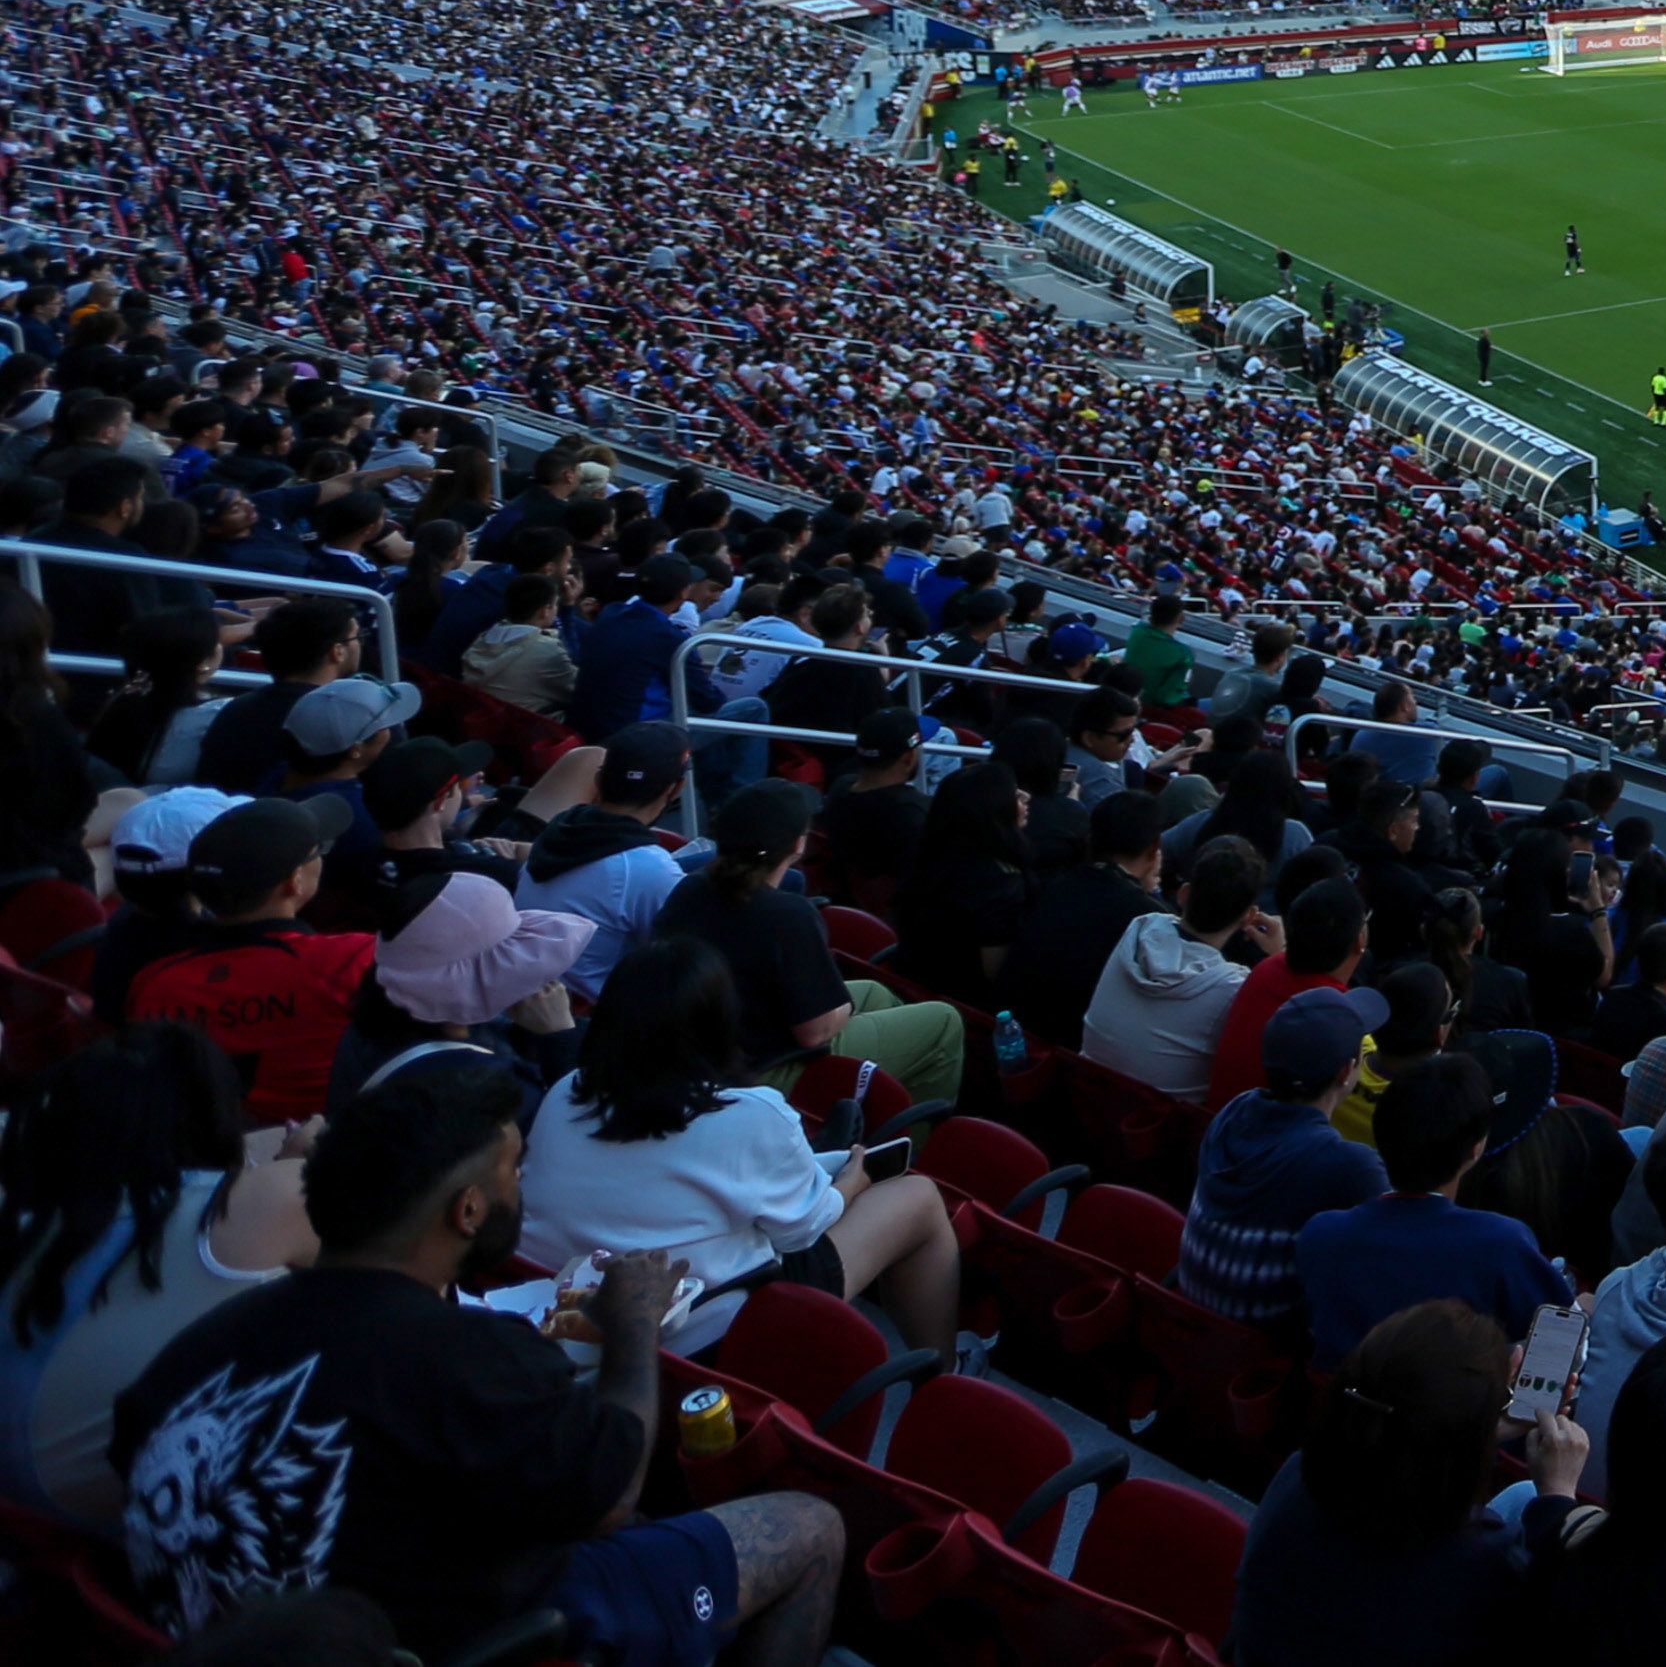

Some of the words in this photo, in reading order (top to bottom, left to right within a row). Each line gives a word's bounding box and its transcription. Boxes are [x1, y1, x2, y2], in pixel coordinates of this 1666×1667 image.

[1584, 37, 1613, 50] Audi
[1182, 66, 1258, 84] atlantic.net
[1373, 357, 1469, 405] EARTH
[1464, 403, 1574, 456] QUAKES
